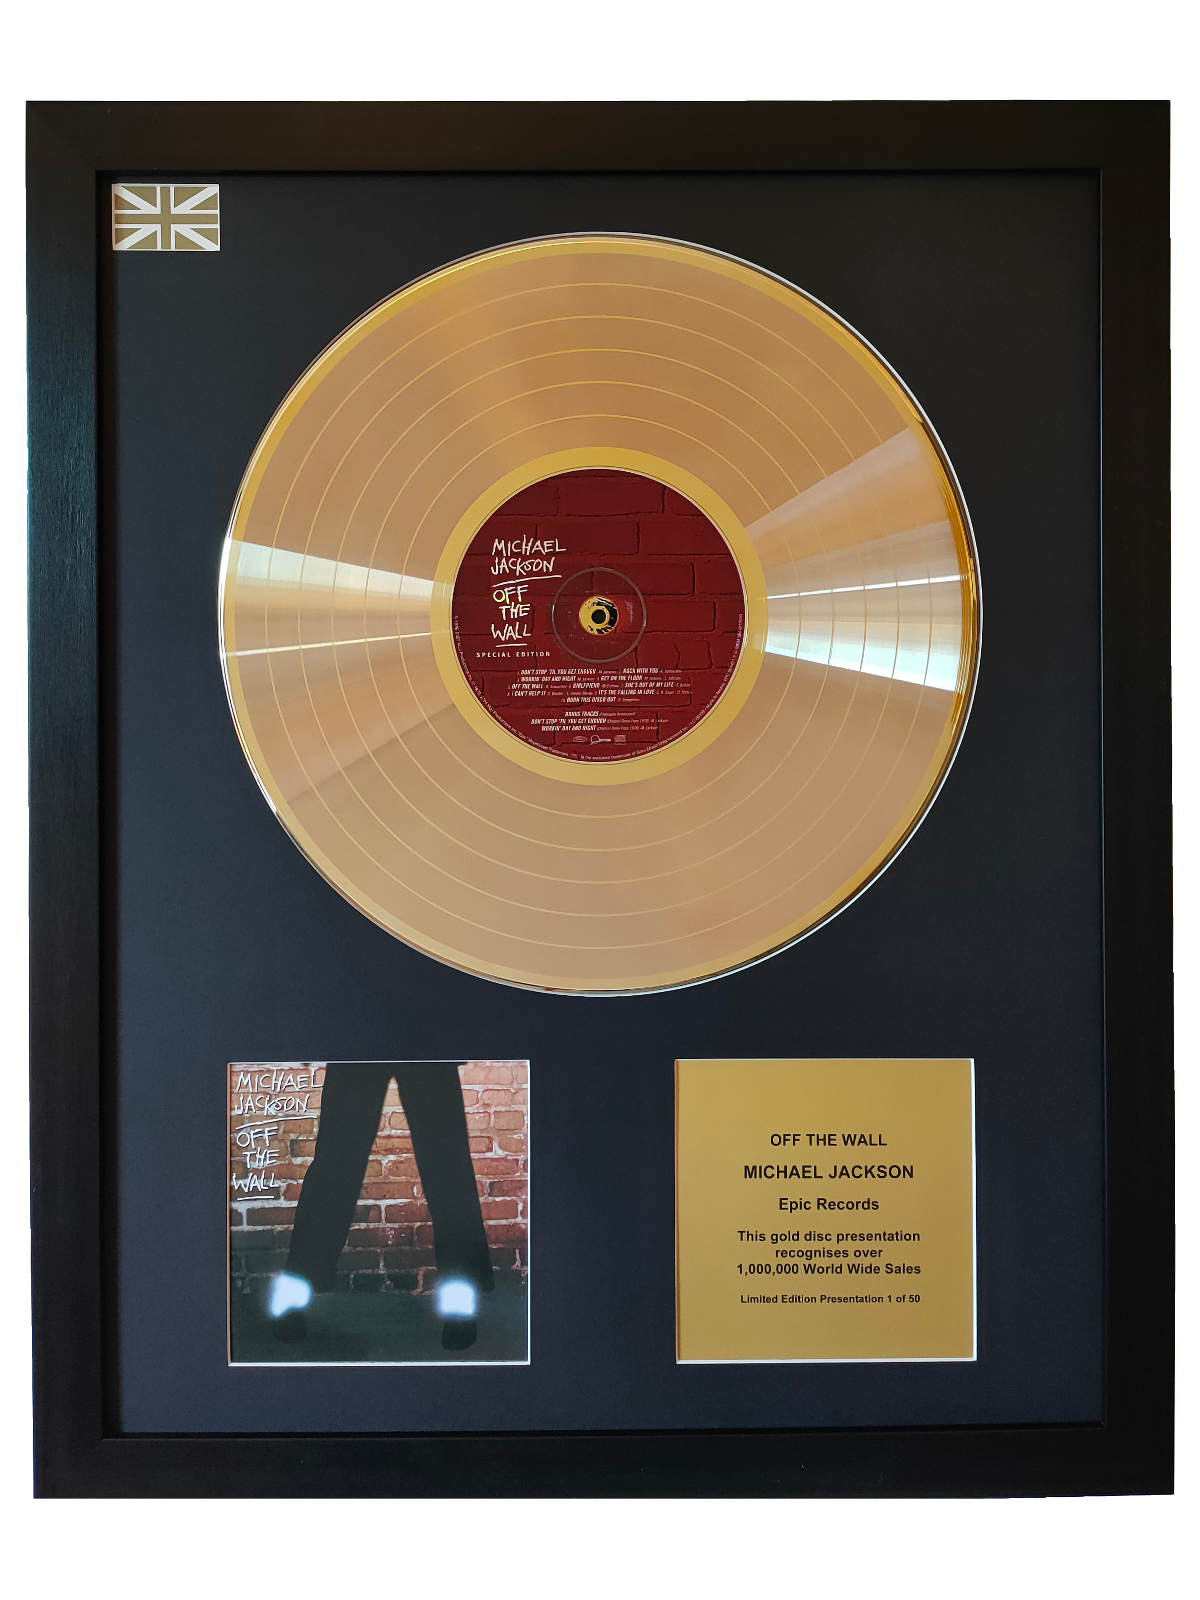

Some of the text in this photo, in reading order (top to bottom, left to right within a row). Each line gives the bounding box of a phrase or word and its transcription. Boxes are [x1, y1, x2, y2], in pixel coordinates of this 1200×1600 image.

[492, 534, 566, 556] MICHAEL
[491, 557, 555, 576] JACKSON
[493, 585, 528, 604] OFF
[499, 602, 530, 620] THE
[491, 622, 531, 641] WALL
[236, 1069, 324, 1092] MICHAEL
[235, 1094, 310, 1116] JACKSON
[236, 1126, 278, 1149] OFF
[770, 1134, 888, 1146] OFF THE WALL
[242, 1147, 279, 1169] THE
[232, 1170, 280, 1192] WALL
[744, 1165, 914, 1179] MICHAEL JACKSON
[779, 1198, 879, 1213] Epic Records
[738, 1231, 920, 1245] This gold disc presentation
[775, 1248, 883, 1260] recognises over
[737, 1264, 921, 1276] 1,000,000 World Wide Sales
[740, 1295, 920, 1304] Limited Edition Presentation 1 of 50
